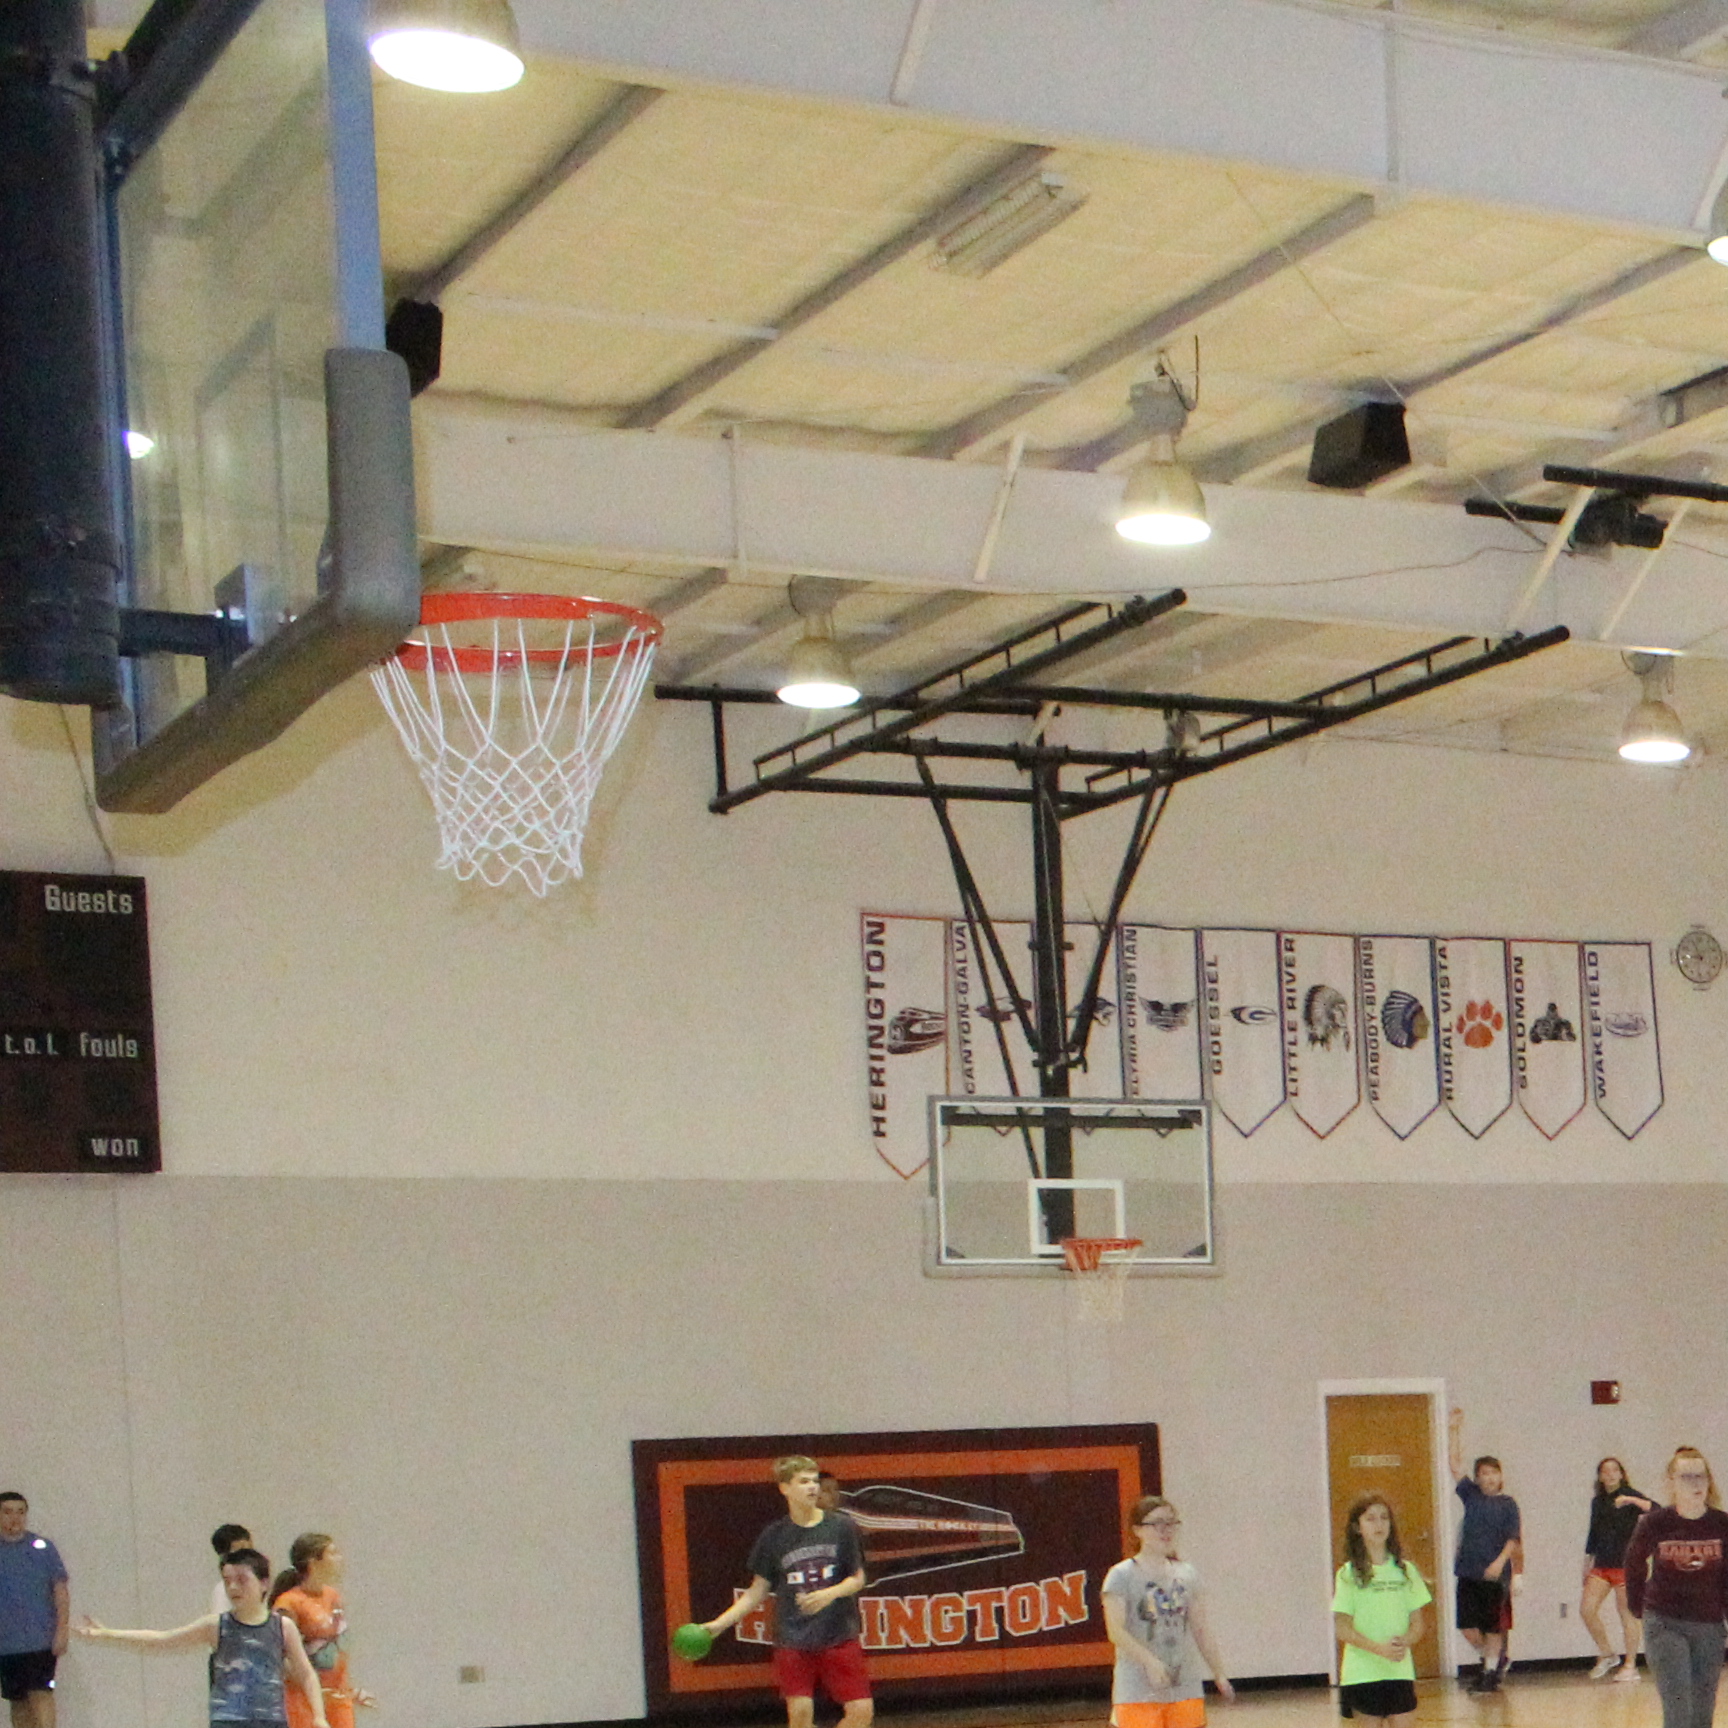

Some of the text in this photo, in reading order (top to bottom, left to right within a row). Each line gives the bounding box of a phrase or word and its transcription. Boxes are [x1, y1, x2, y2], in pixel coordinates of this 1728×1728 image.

[44, 884, 134, 915] Guests
[866, 920, 887, 1138] HERINGTON
[1124, 928, 1138, 1028] CHRISTIAN
[1206, 955, 1222, 1075] GOESSEL
[1284, 937, 1299, 1098] LITTLE RIVER
[1438, 946, 1454, 1101] RURAL VISTA
[1587, 951, 1606, 1098] WAKEFIELD
[80, 1033, 139, 1059] fouls
[91, 1137, 140, 1158] won
[733, 1570, 1089, 1650] HINGTON
